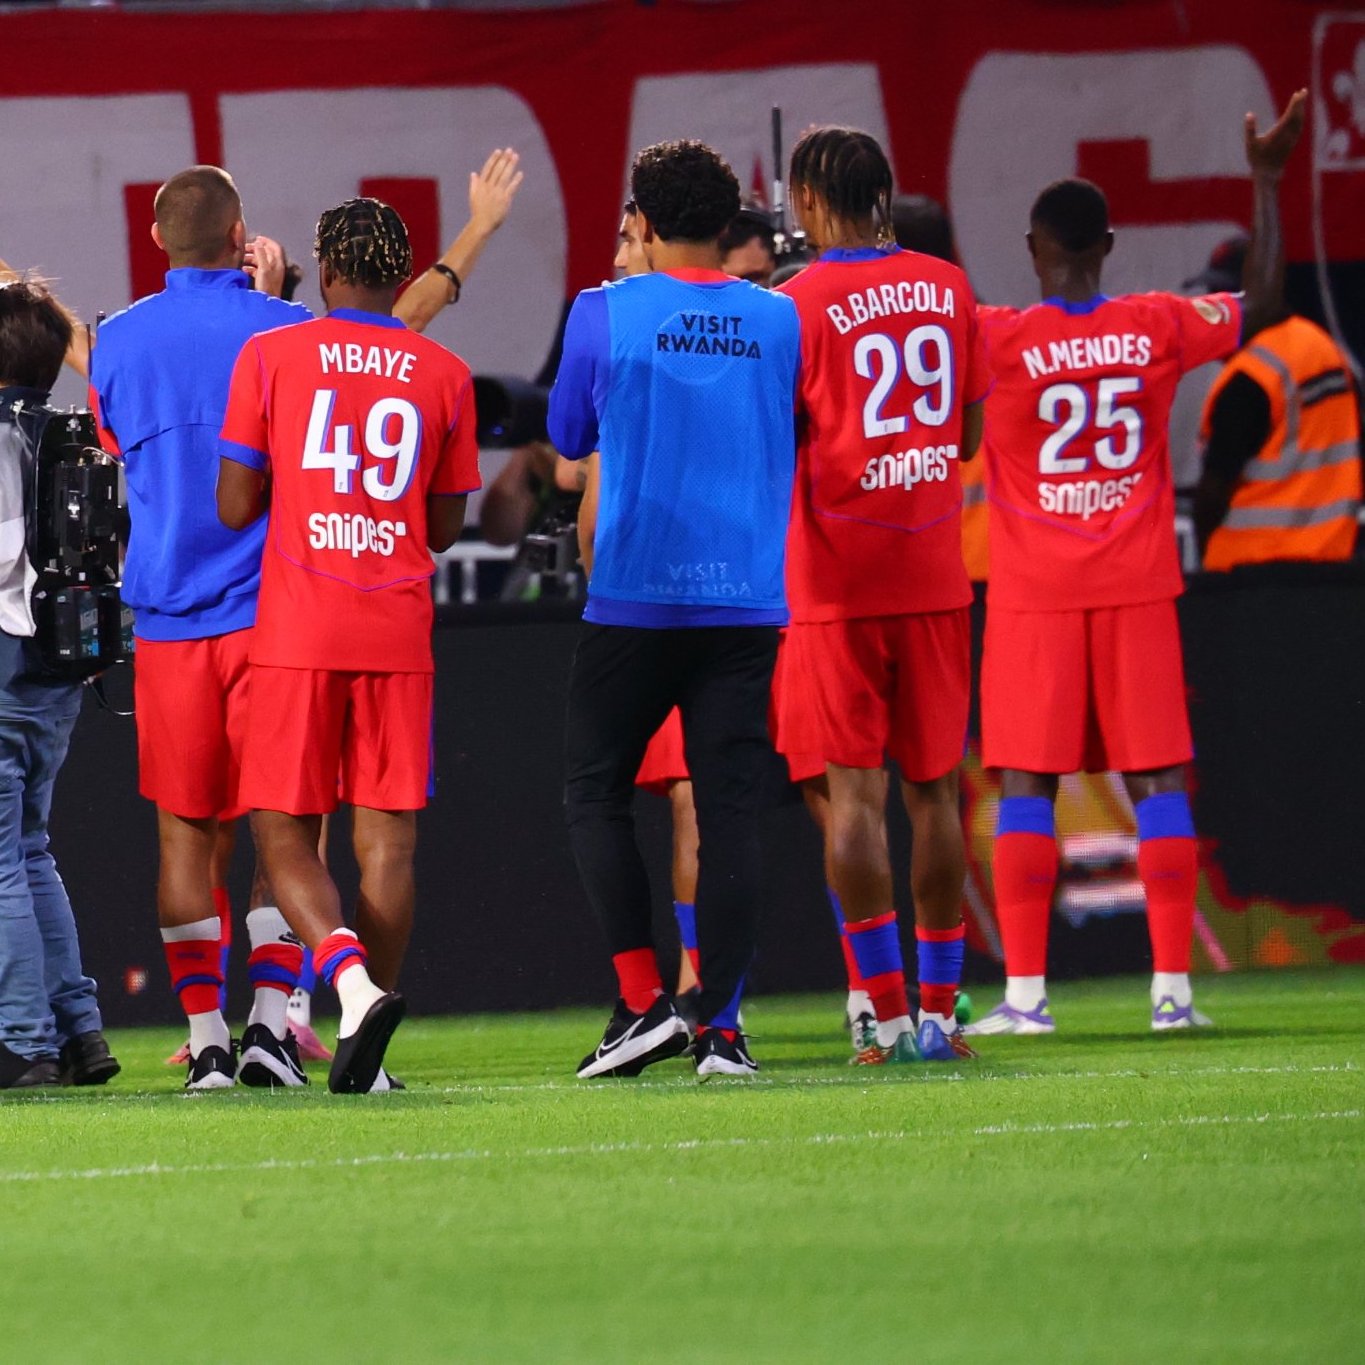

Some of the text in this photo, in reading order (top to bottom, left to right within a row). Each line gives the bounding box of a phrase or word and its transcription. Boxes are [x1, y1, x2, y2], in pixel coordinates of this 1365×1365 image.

[681, 313, 742, 336] VISIT
[826, 280, 955, 335] B.BARCOLA
[319, 343, 417, 384] MBAYE
[657, 333, 762, 360] RWANDA
[1022, 334, 1151, 378] N.MENDES
[854, 325, 955, 439] 29
[301, 389, 423, 502] 49
[1038, 377, 1143, 475] 25
[861, 447, 948, 491] snipes
[1040, 479, 1133, 520] snipes
[309, 512, 395, 558] snipes
